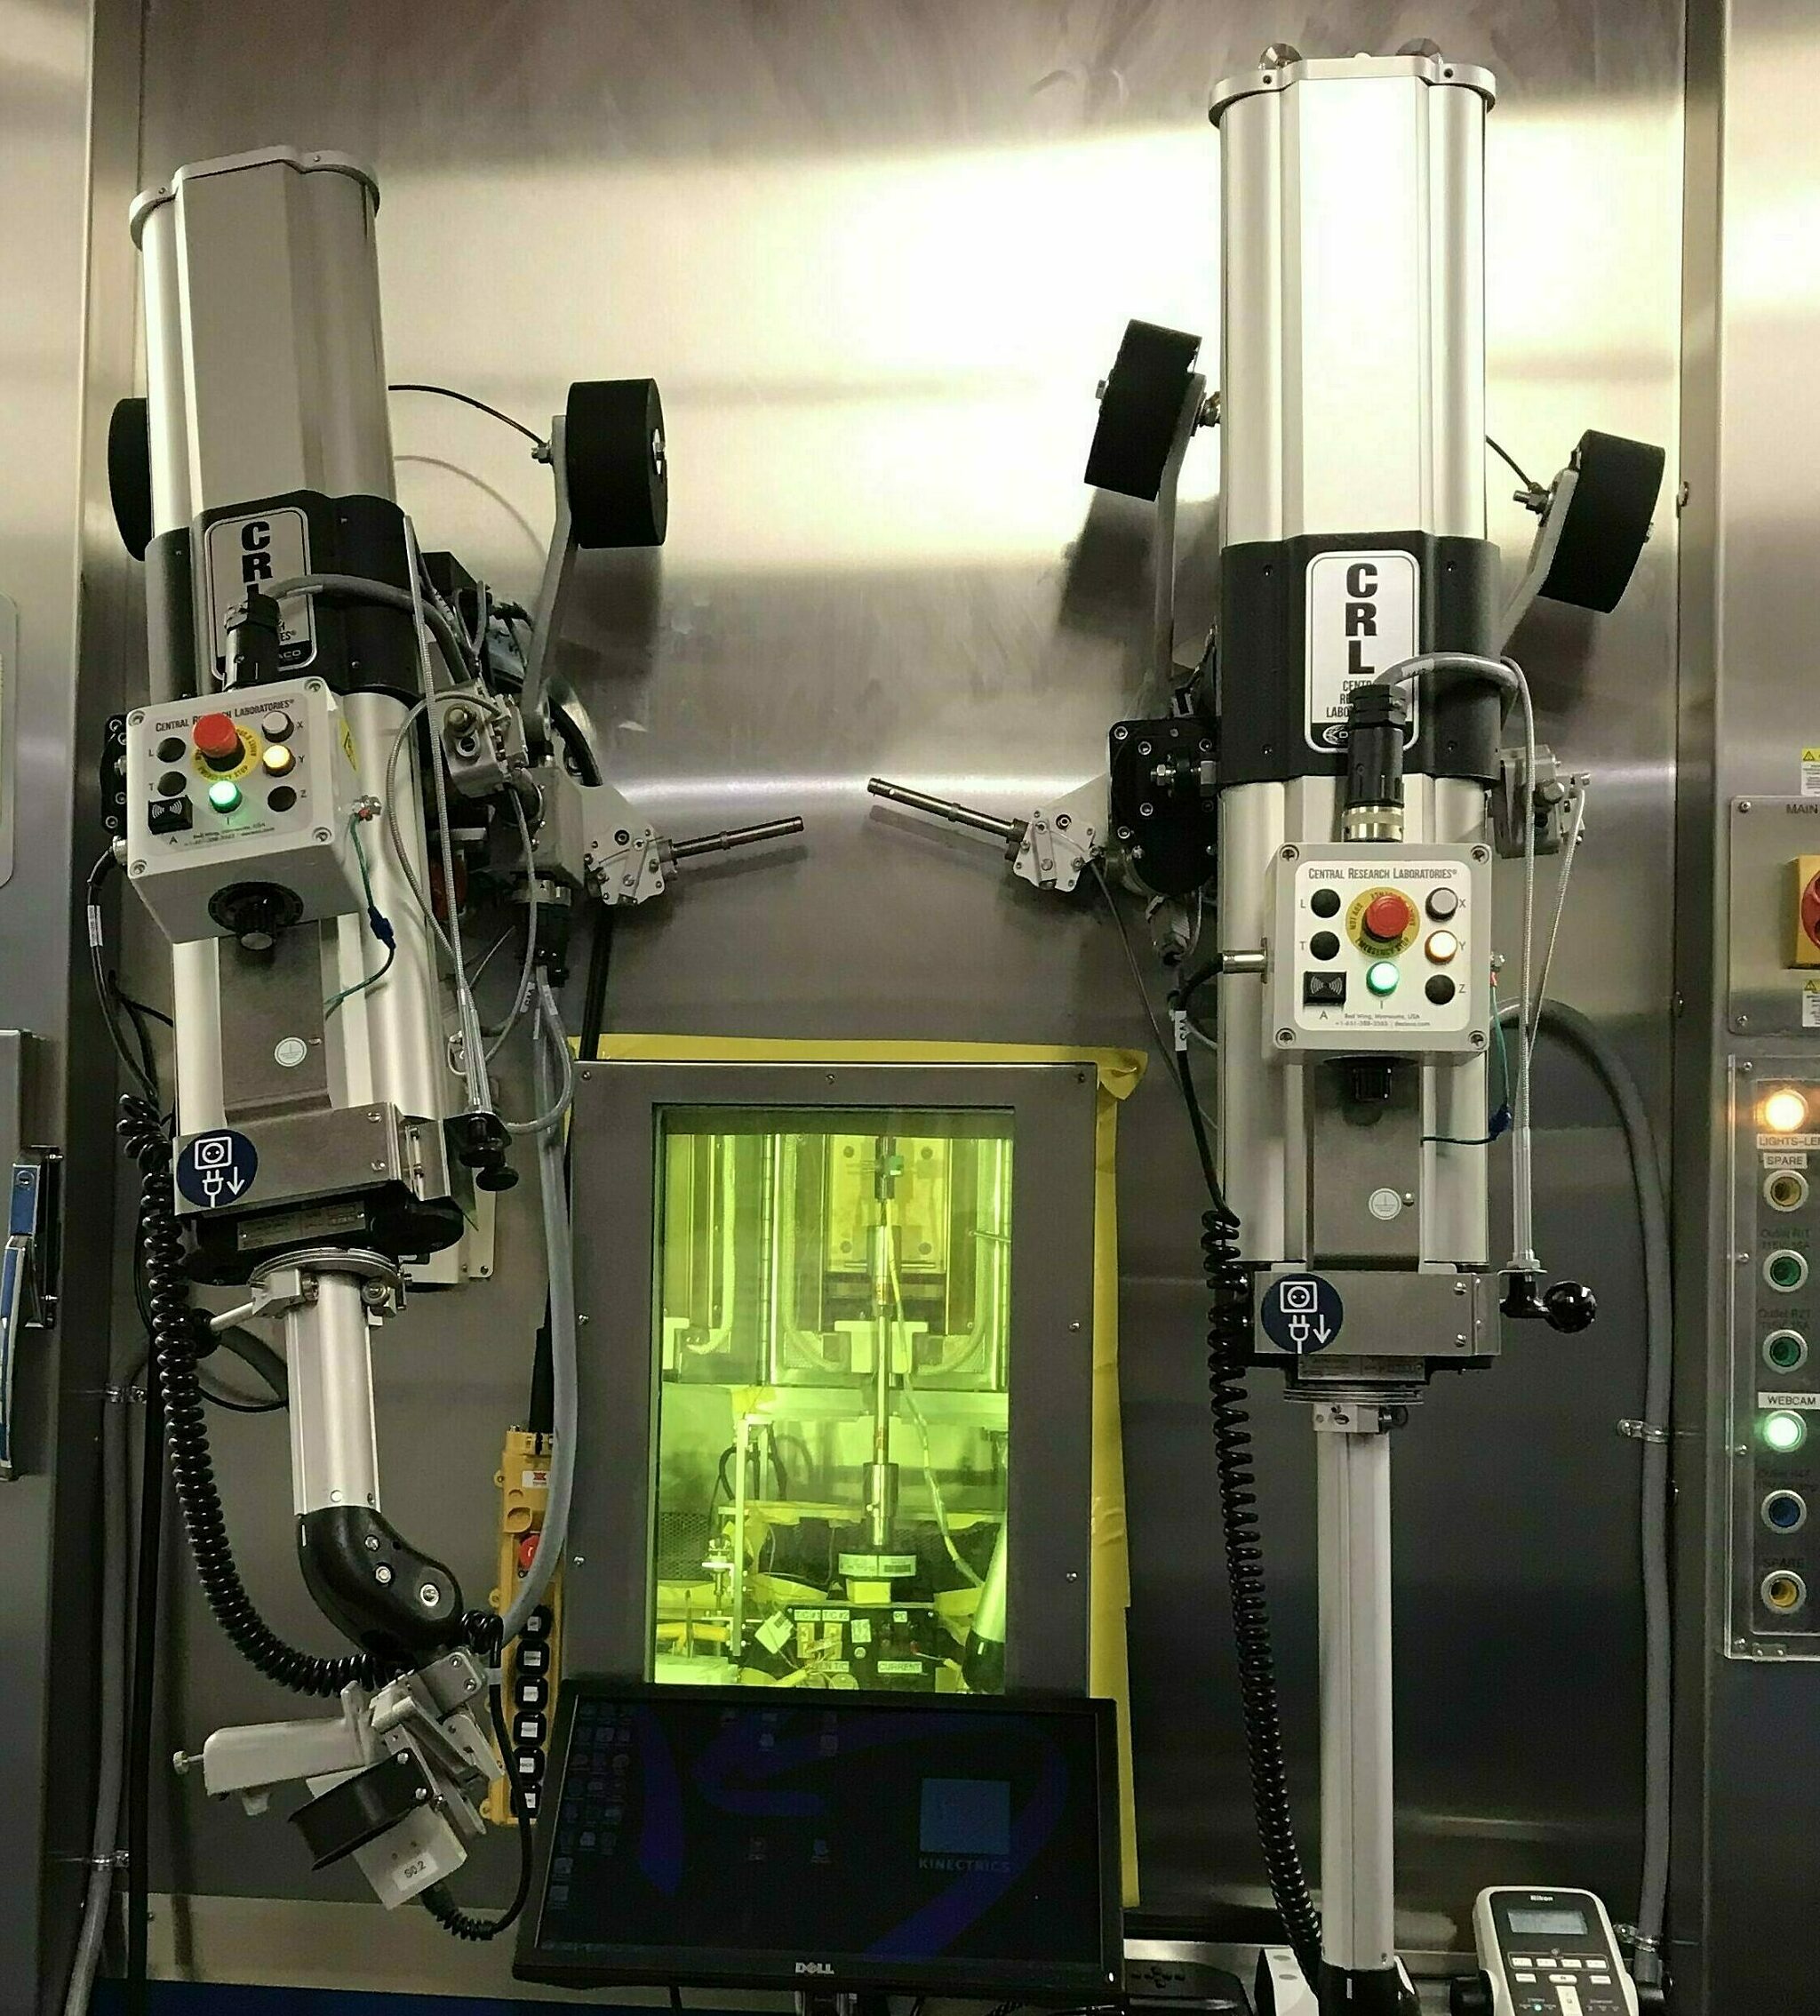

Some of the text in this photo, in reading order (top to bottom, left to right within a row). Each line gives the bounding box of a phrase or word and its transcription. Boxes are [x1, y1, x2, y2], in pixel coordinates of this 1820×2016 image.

[1345, 563, 1377, 674] CRL
[156, 720, 189, 732] CENTRAL
[297, 721, 304, 729] X
[148, 748, 154, 757] L
[299, 755, 306, 764] Y
[148, 782, 154, 791] T
[300, 790, 307, 799] Z
[1786, 804, 1818, 814] MAIN
[169, 836, 178, 845] A
[1308, 868, 1345, 879] CENTRAL
[1348, 868, 1390, 879] RESEARCH
[1300, 899, 1306, 908] L
[1458, 899, 1466, 908] X
[1299, 940, 1305, 950] T
[1458, 941, 1466, 950] Y
[1458, 984, 1466, 993] Z
[1320, 1011, 1329, 1020] A
[1768, 1156, 1803, 1165] SPARE
[1768, 1396, 1816, 1405] WEBCAM
[878, 1663, 922, 1671] CURRENT
[794, 1962, 835, 1974] DELL
